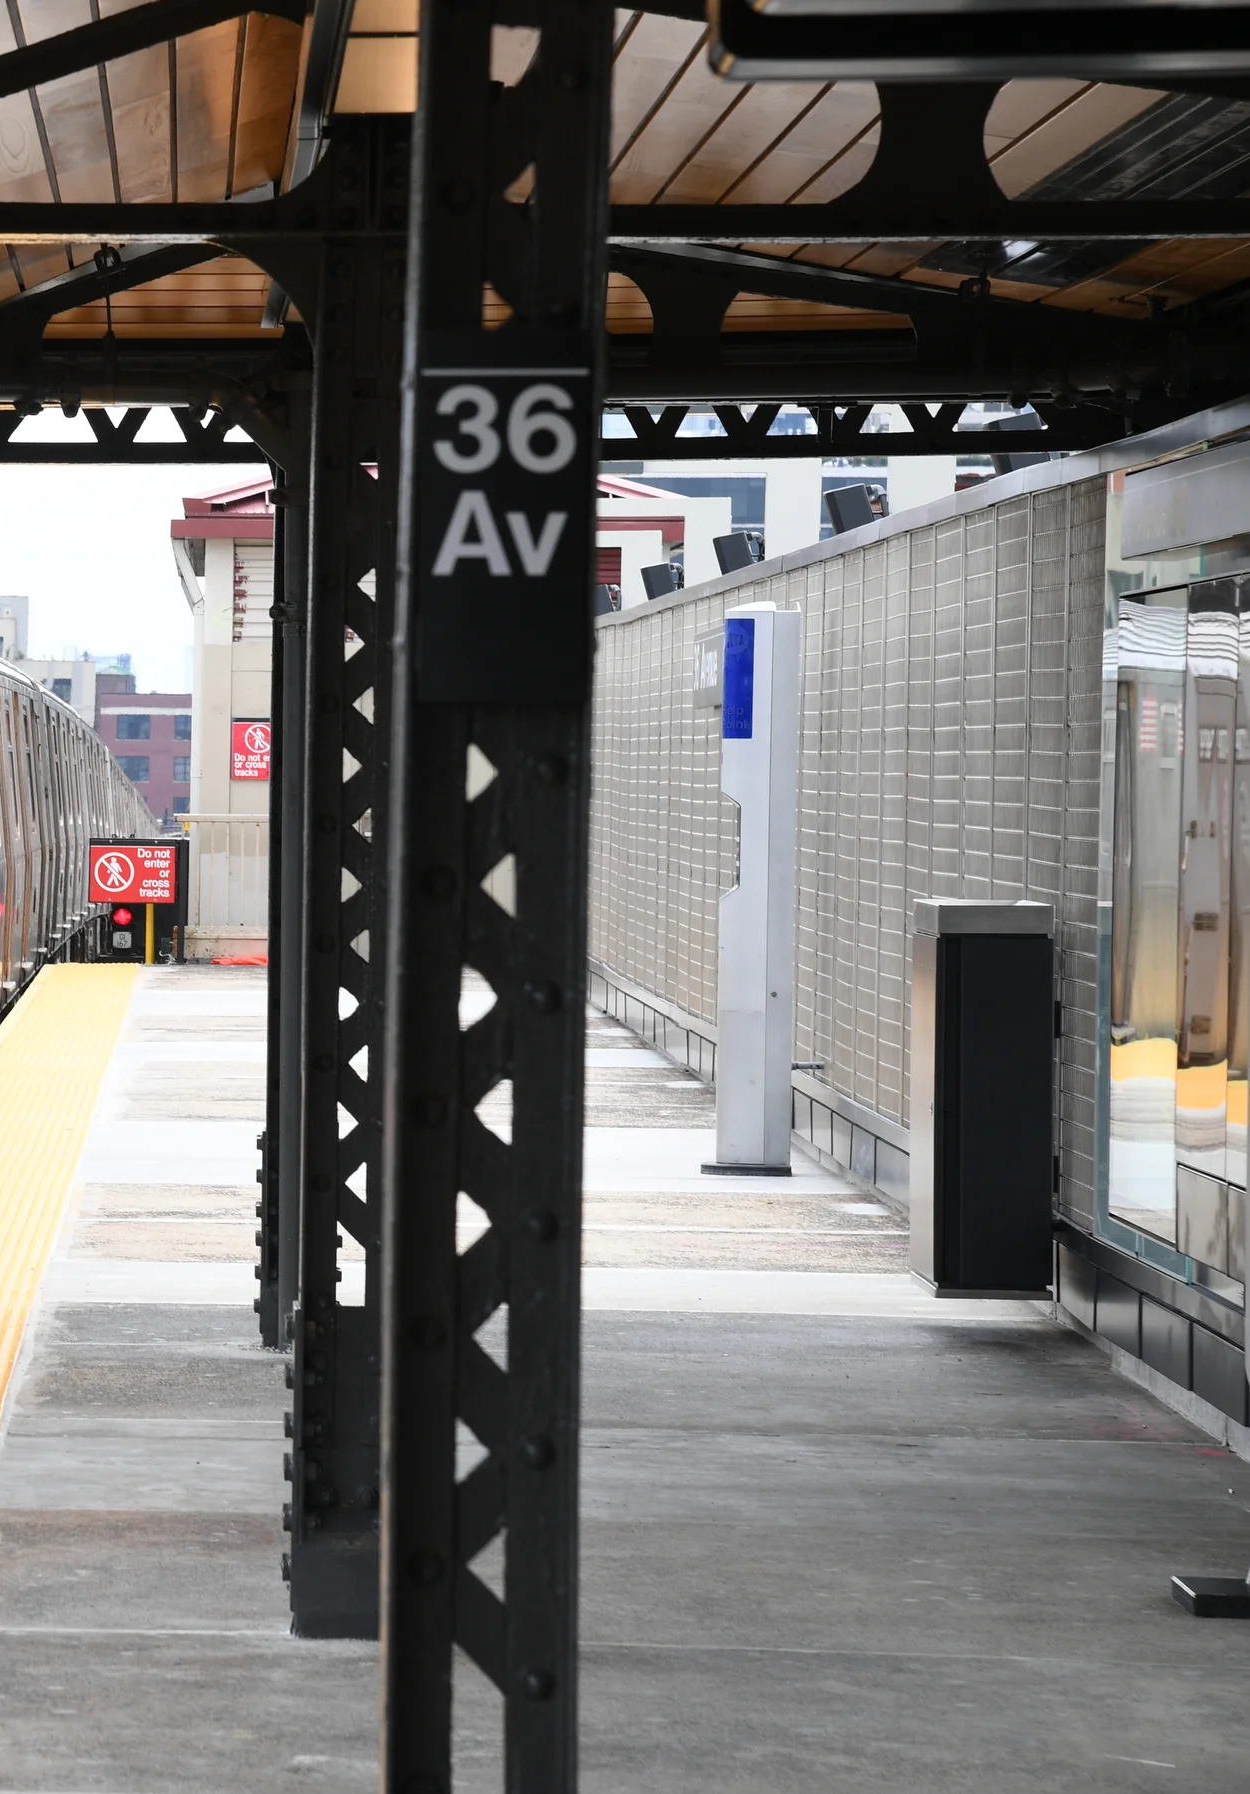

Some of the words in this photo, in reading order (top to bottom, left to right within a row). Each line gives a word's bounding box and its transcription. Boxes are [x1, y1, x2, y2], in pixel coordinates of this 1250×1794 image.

[432, 383, 577, 474] 36
[430, 489, 568, 577] Av
[234, 753, 246, 762] Do
[248, 753, 260, 762] not
[234, 768, 259, 777] tracks
[137, 848, 152, 859] Do
[154, 849, 170, 859] not
[144, 859, 170, 868] enter
[159, 869, 170, 878] or
[142, 879, 170, 888] cross
[139, 887, 170, 898] tracks
